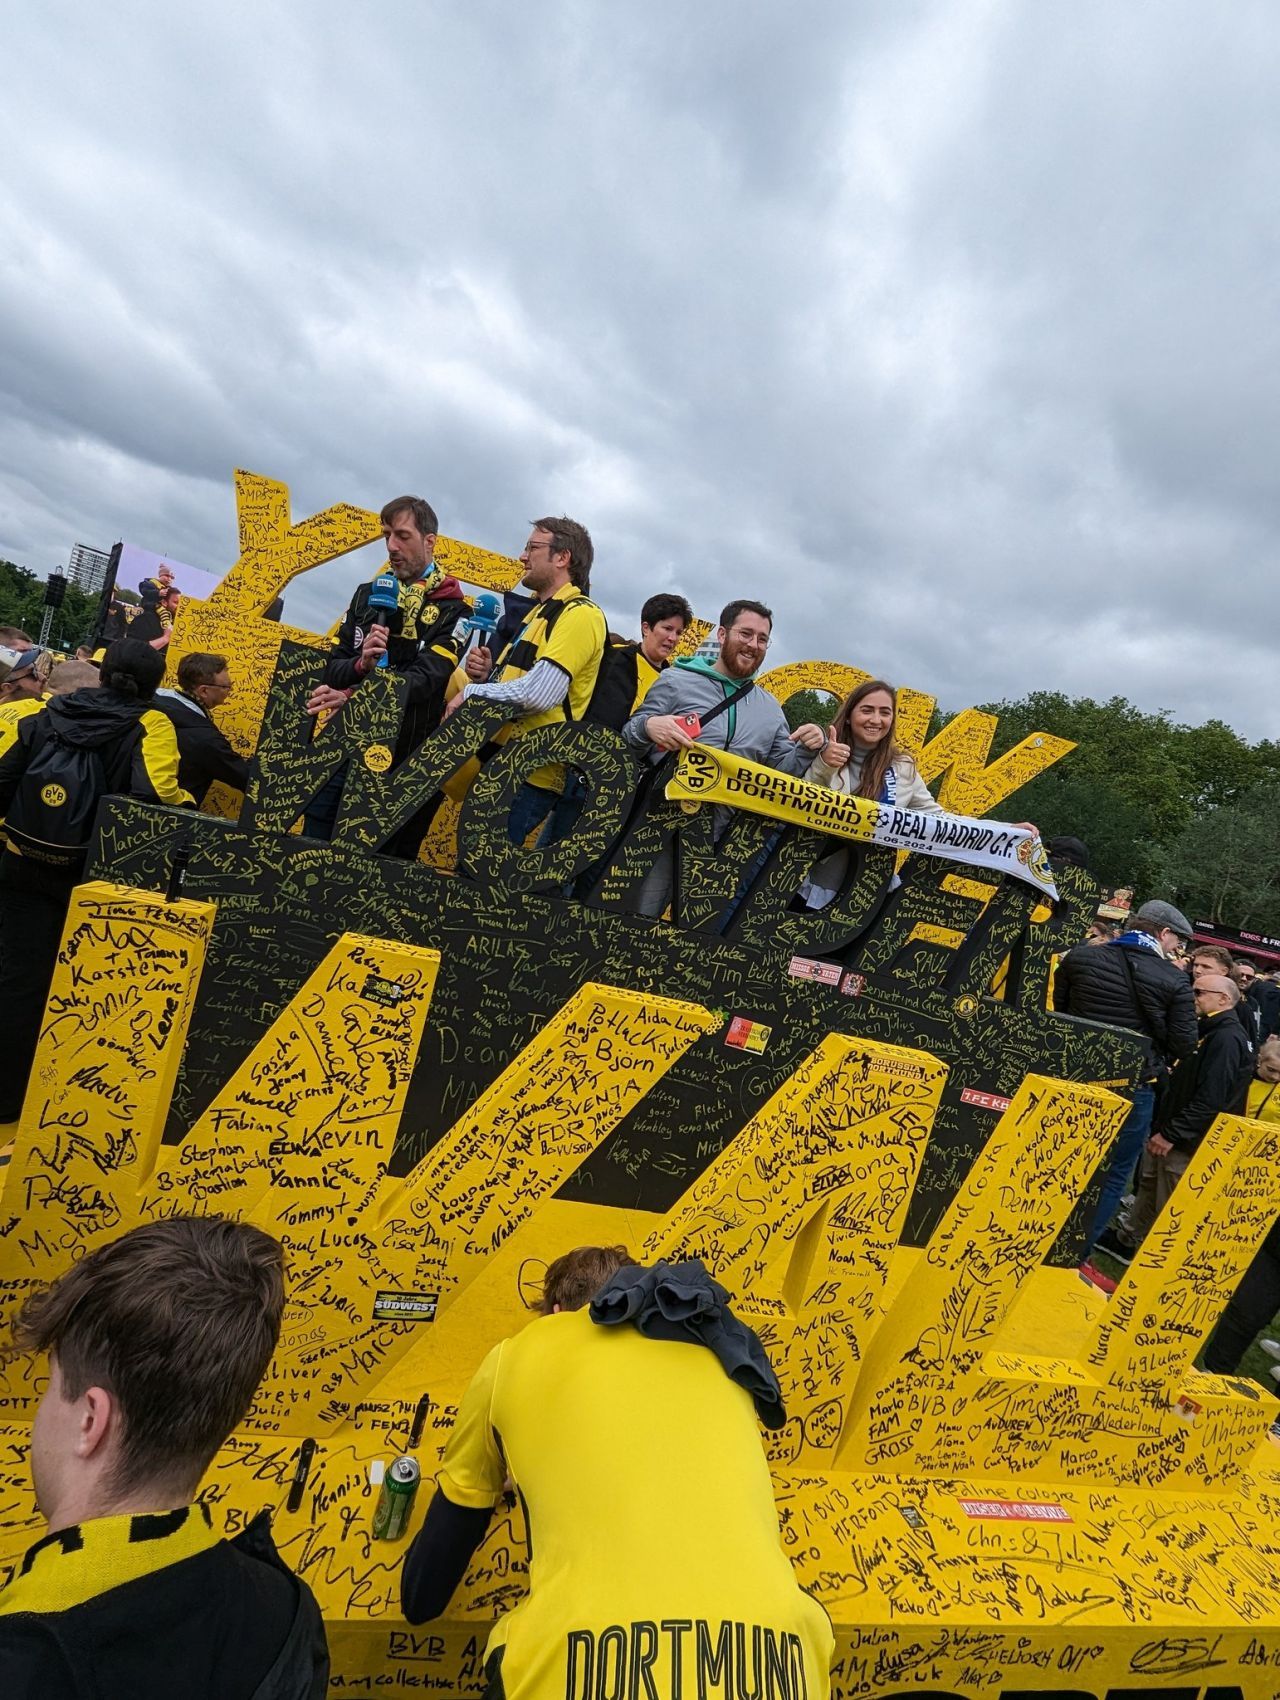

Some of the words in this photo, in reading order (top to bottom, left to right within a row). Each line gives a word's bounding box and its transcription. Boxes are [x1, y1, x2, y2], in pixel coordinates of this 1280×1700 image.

[423, 607, 438, 620] BVB
[689, 752, 715, 788] BVB
[45, 786, 64, 801] BVB
[726, 780, 861, 825] DORTMUND
[736, 768, 858, 811] BORUSSIA
[806, 816, 858, 836] LONDON
[862, 831, 935, 851] 01-06-2024
[889, 810, 927, 840] REAL
[931, 820, 994, 851] MADRID
[990, 834, 1018, 858] C.F.
[624, 841, 664, 857] Manuel
[1240, 931, 1261, 942] DOGS
[72, 959, 173, 988] Karsten
[709, 961, 743, 986] Tim
[634, 1006, 672, 1027] Aida
[437, 1025, 509, 1064] Dean
[867, 1064, 923, 1080] DORTMUND
[870, 1056, 921, 1073] BORUSSIA
[555, 1078, 642, 1120] SVENJA
[991, 1097, 1010, 1110] KÖ
[340, 1321, 416, 1385] Marcel
[908, 1395, 946, 1417] BVB
[390, 1632, 447, 1658] BVB
[567, 1619, 808, 1700] DORTMUND
